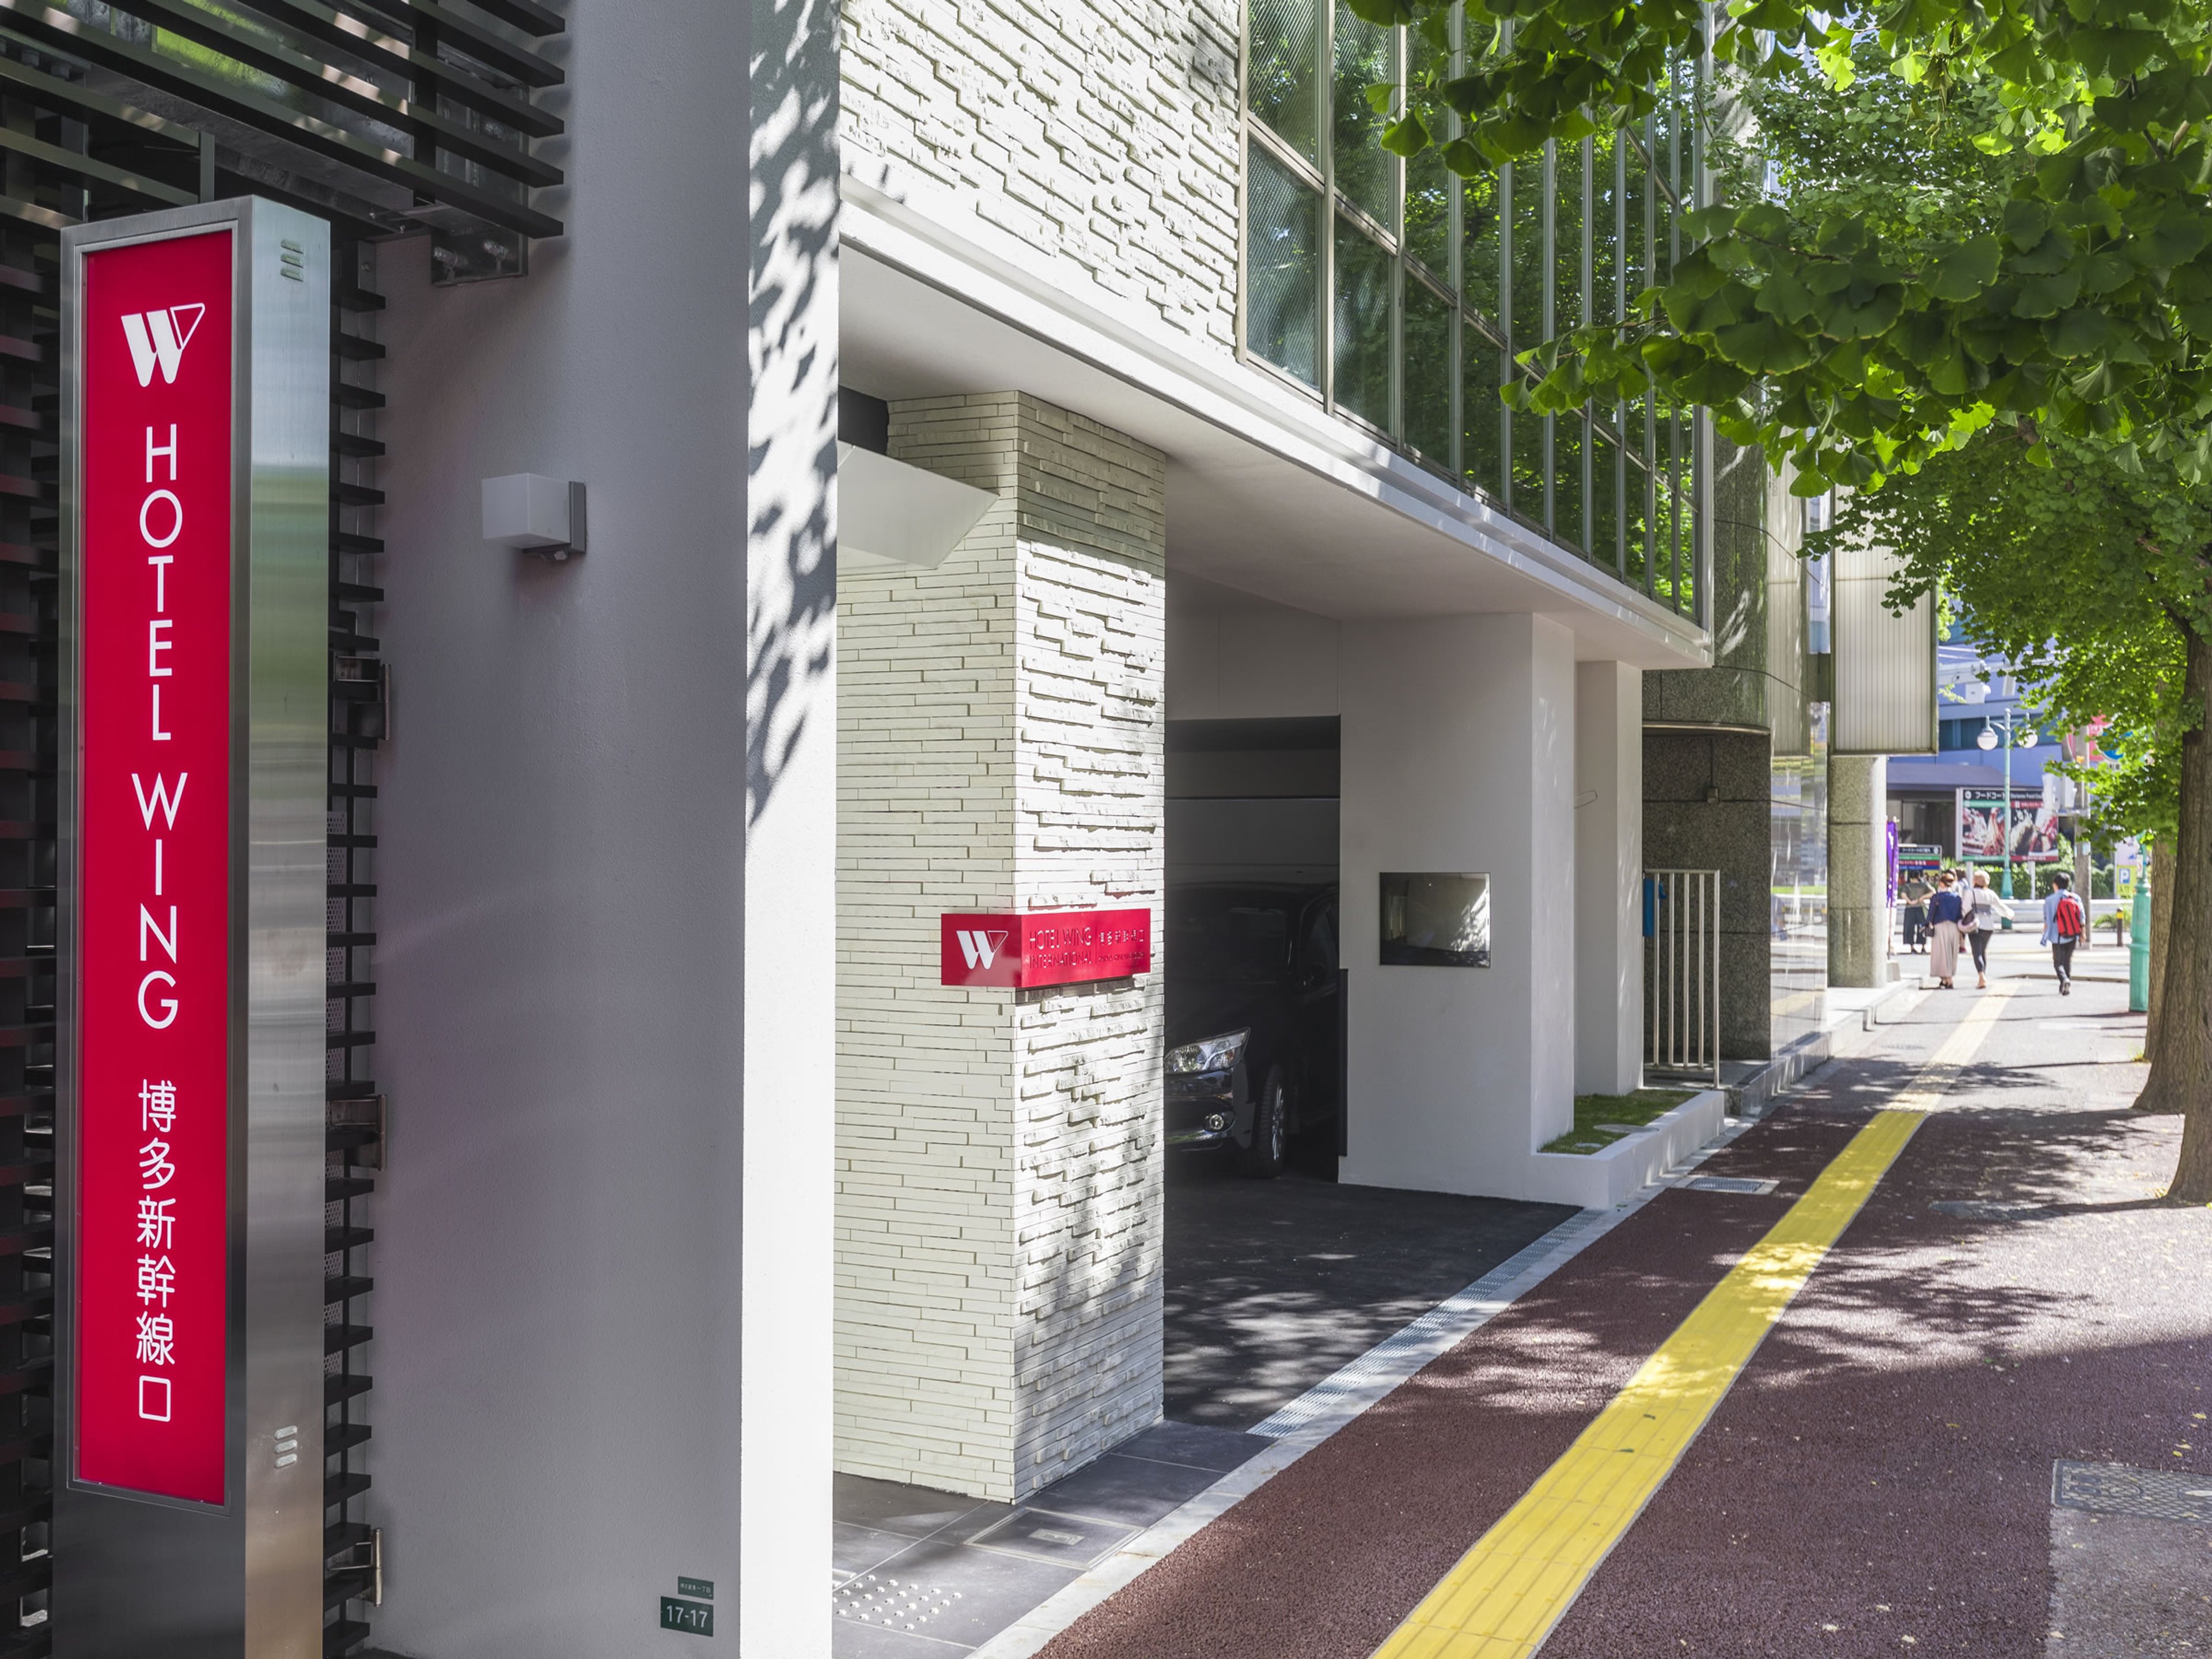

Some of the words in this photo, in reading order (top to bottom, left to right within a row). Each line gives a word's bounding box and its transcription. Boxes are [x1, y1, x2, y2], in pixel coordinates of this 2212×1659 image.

[139, 423, 183, 741] HOTEL
[131, 772, 188, 1029] WING
[1029, 929, 1060, 950] HOTEL
[1063, 926, 1092, 946] WING
[1029, 951, 1092, 969] INTERNATIONAL
[136, 1078, 177, 1422] 博多新幹線口
[667, 1605, 708, 1628] 17-17
